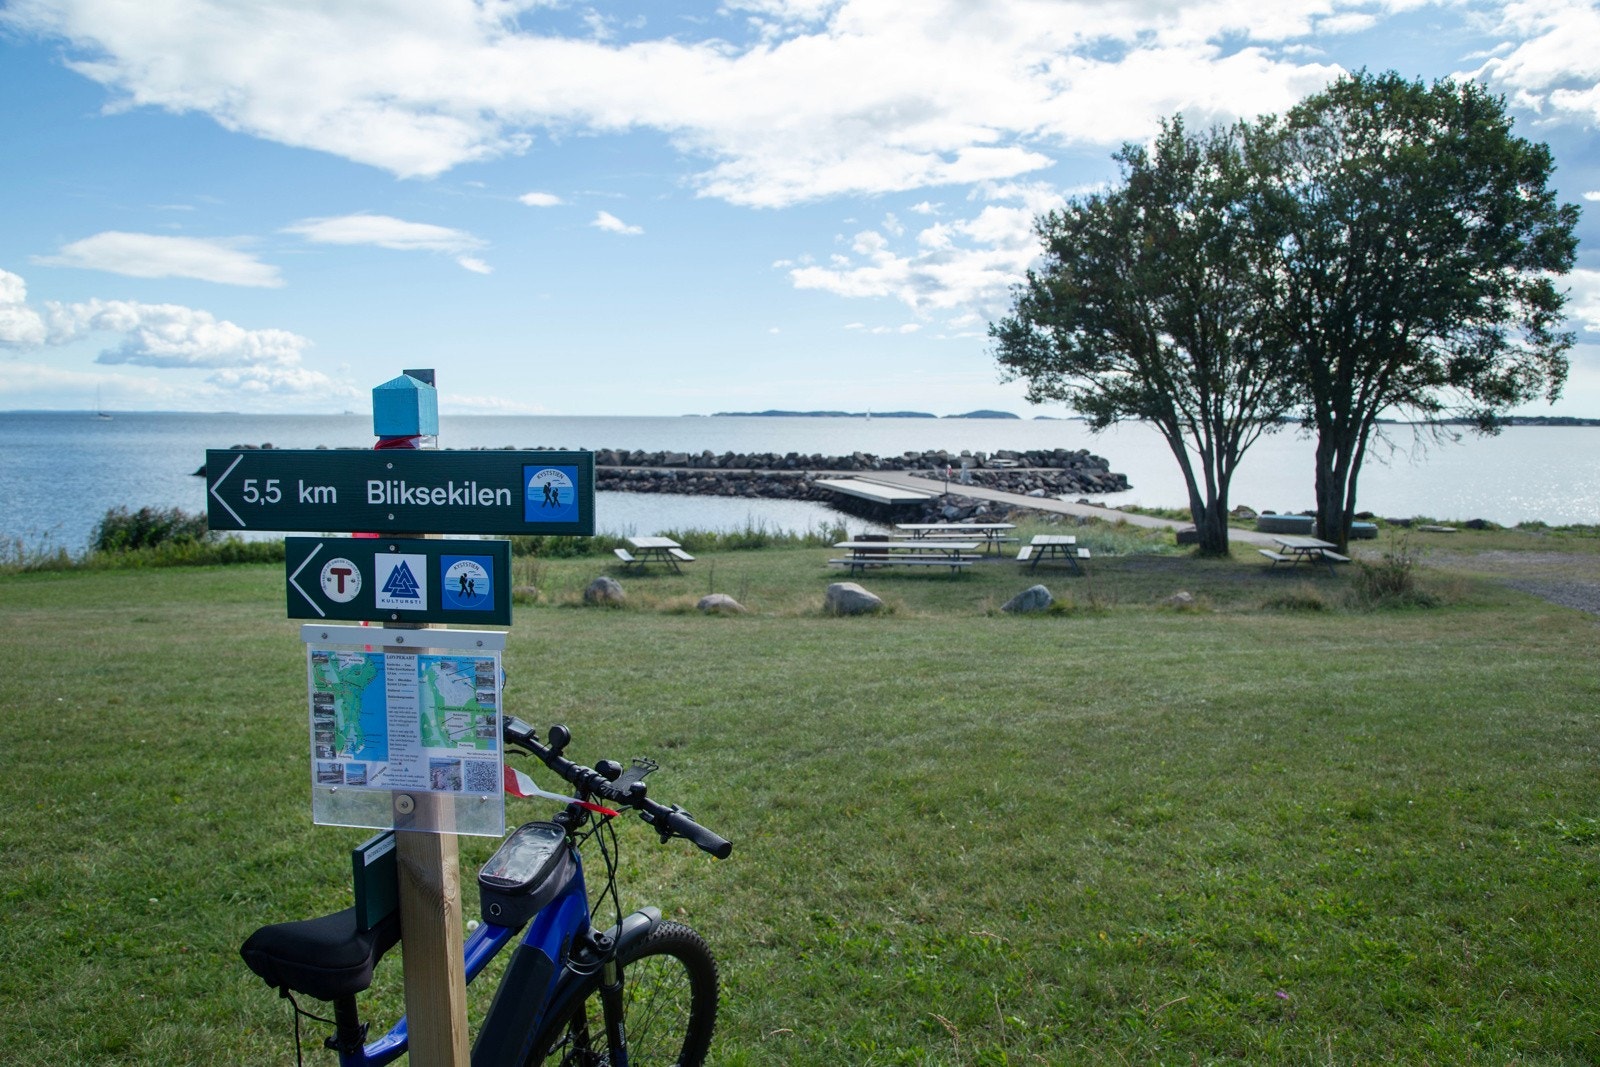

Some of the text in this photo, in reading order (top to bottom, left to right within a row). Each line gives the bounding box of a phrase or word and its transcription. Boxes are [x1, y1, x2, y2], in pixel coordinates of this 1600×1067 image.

[536, 470, 565, 480] KYSTSTIEN
[243, 479, 512, 506] 5,5 km Bliksekilen
[453, 562, 480, 571] KYSTSTIEN
[330, 568, 352, 594] T
